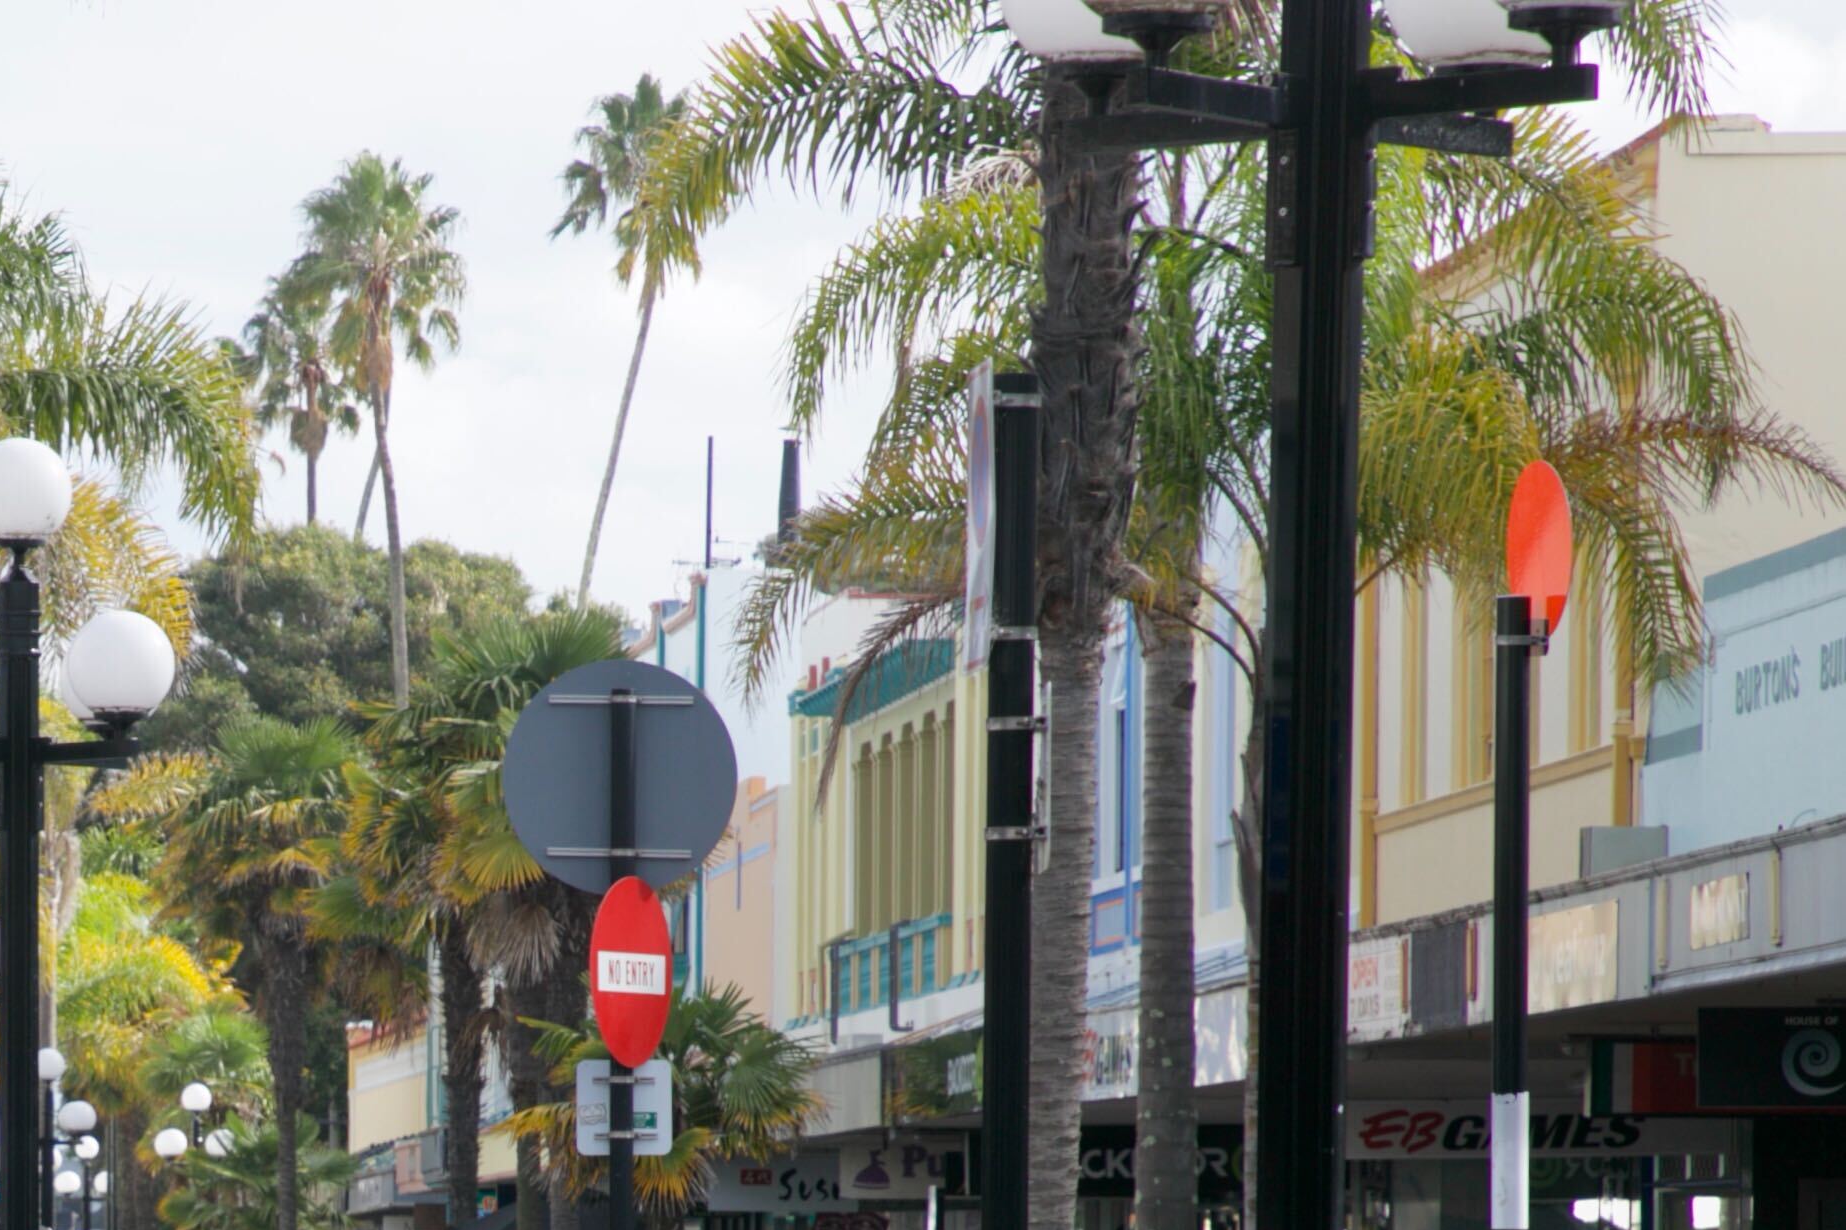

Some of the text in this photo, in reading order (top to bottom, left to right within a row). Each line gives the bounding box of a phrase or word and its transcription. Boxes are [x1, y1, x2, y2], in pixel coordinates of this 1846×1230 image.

[608, 959, 655, 987] NO ENTRY
[1784, 1016, 1839, 1025] HOUSE OF
[1359, 1110, 1645, 1153] EB GMES
